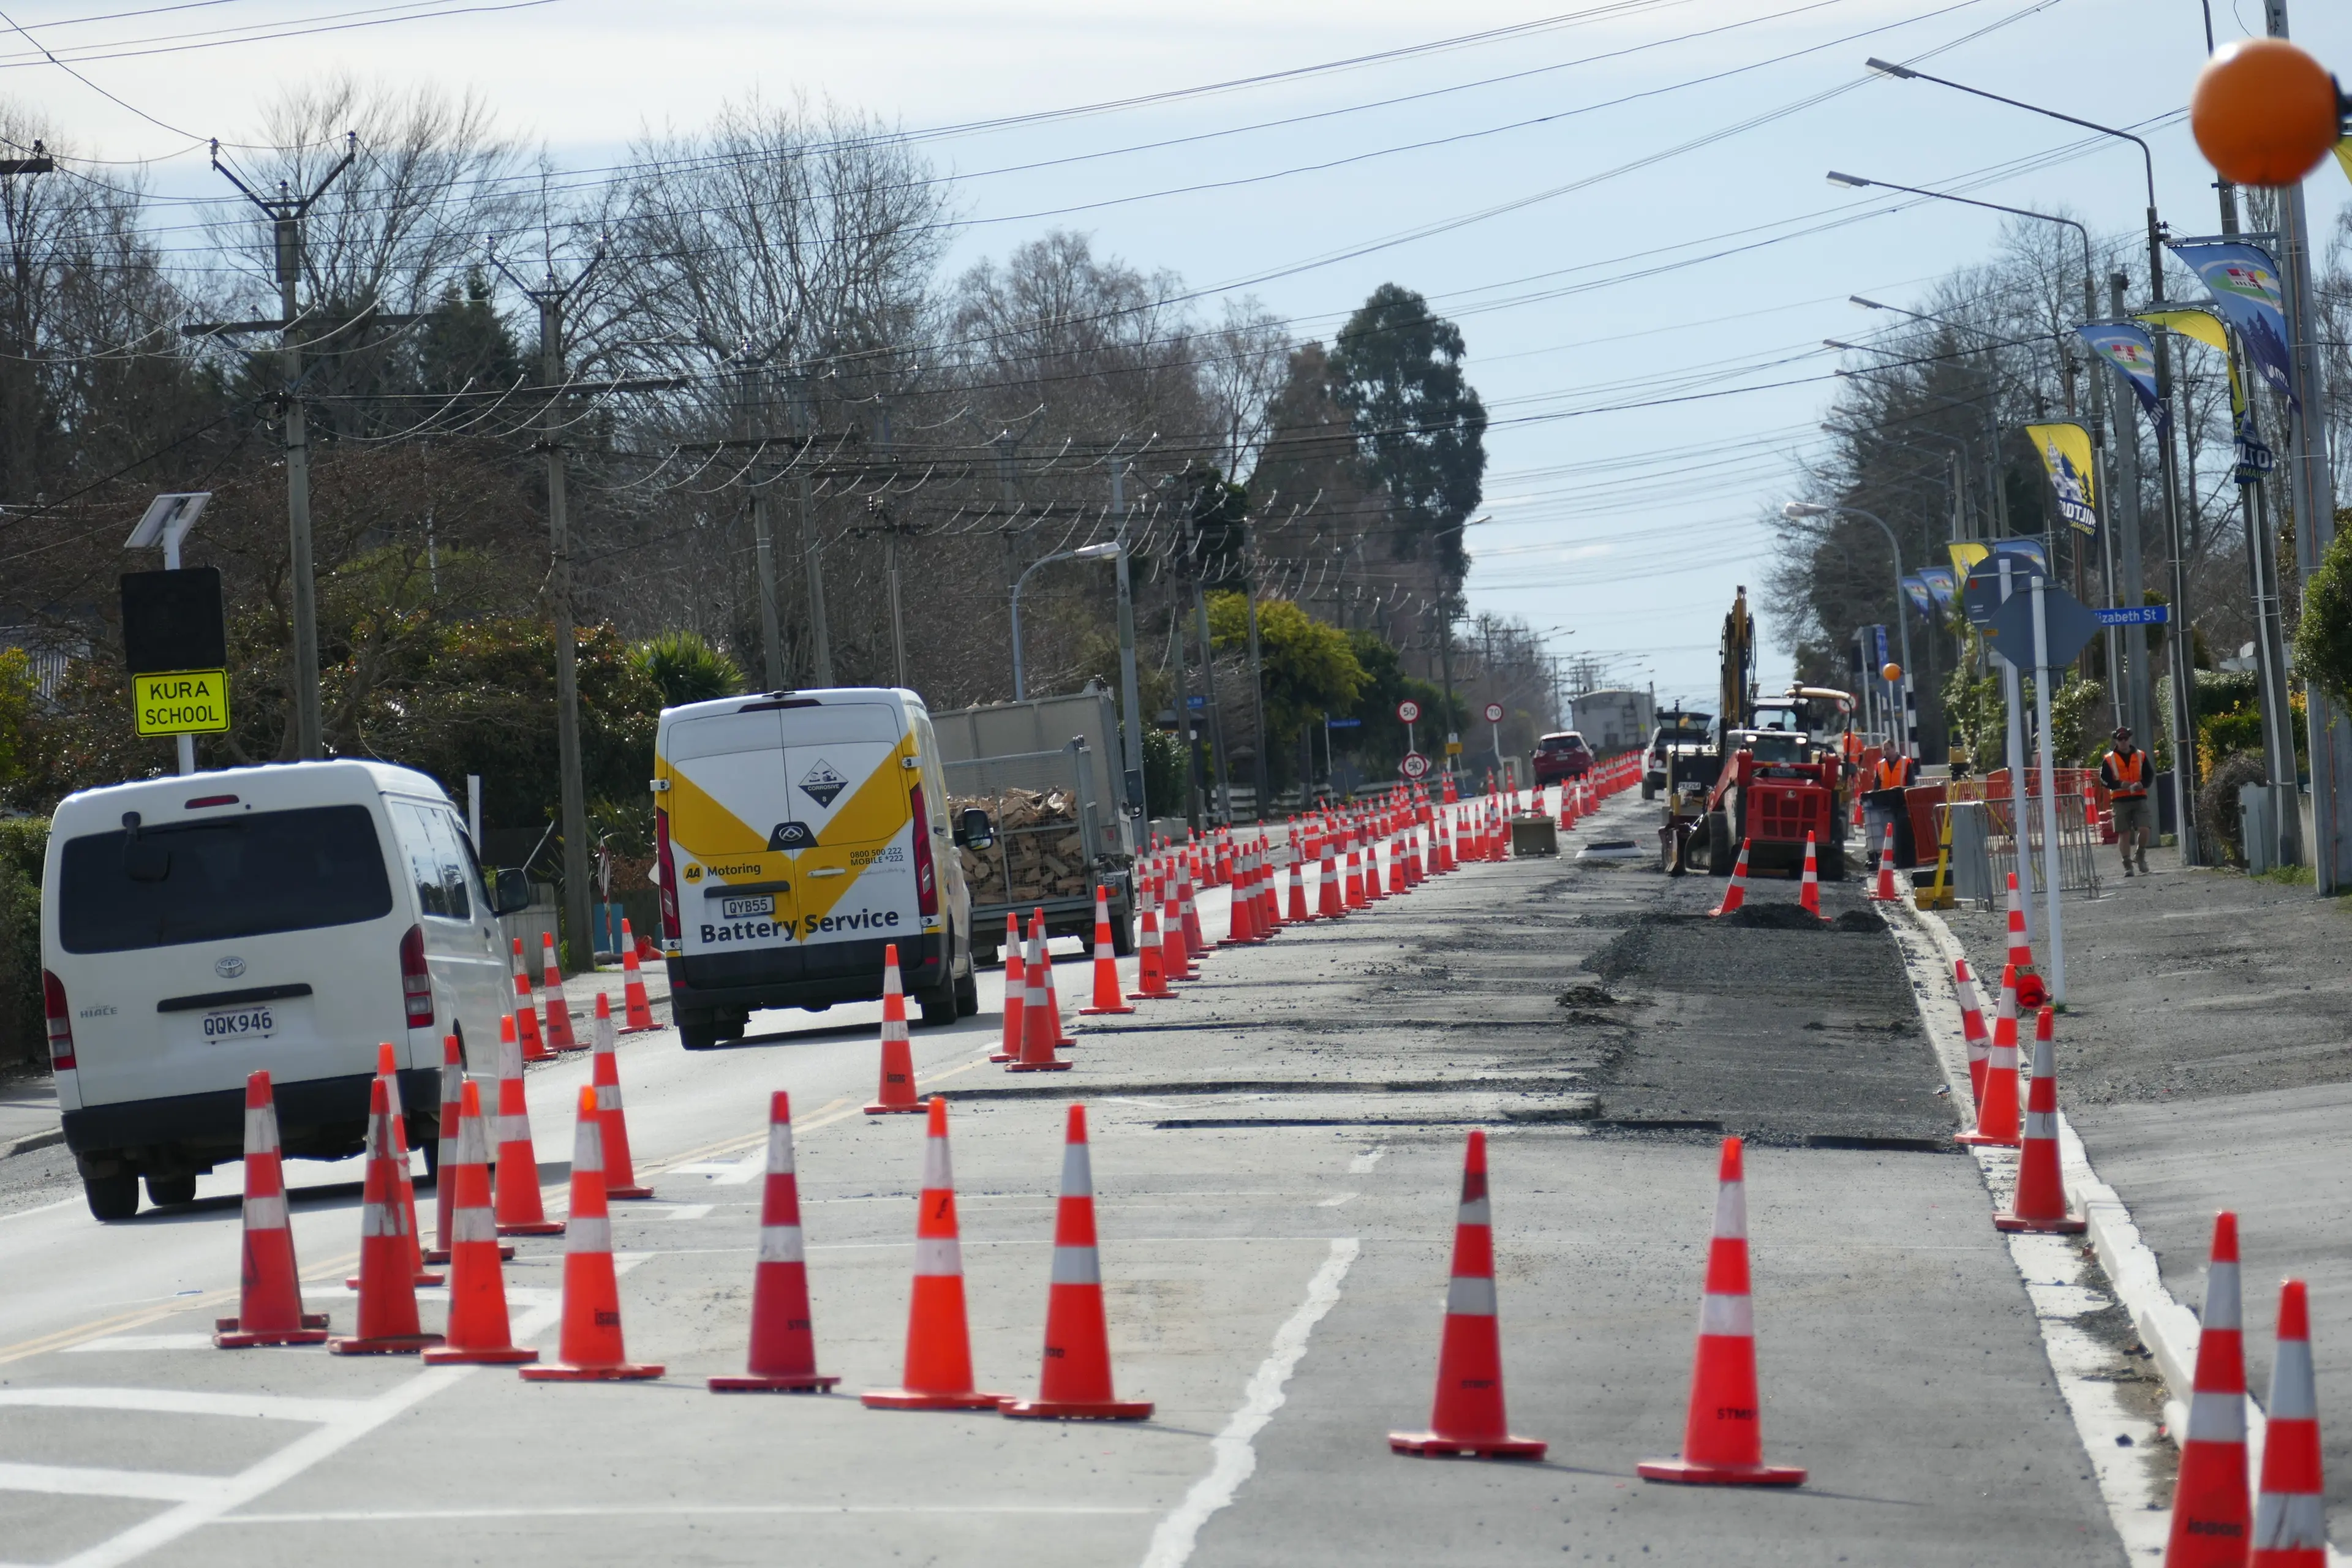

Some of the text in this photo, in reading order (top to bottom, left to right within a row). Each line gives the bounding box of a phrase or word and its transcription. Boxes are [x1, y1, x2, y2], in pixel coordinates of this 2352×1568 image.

[2144, 609, 2157, 621] St
[150, 680, 210, 700] KURA
[146, 706, 219, 725] SCHOOL
[1403, 707, 1416, 716] 50
[1489, 708, 1500, 717] 70
[1408, 761, 1421, 771] 50
[850, 856, 883, 866] MOBILE
[685, 863, 761, 879] AA Motoring
[729, 899, 767, 914] QYB55
[700, 908, 899, 943] Battery Service
[80, 1006, 118, 1019] HIACE
[204, 1012, 273, 1036] QQK946
